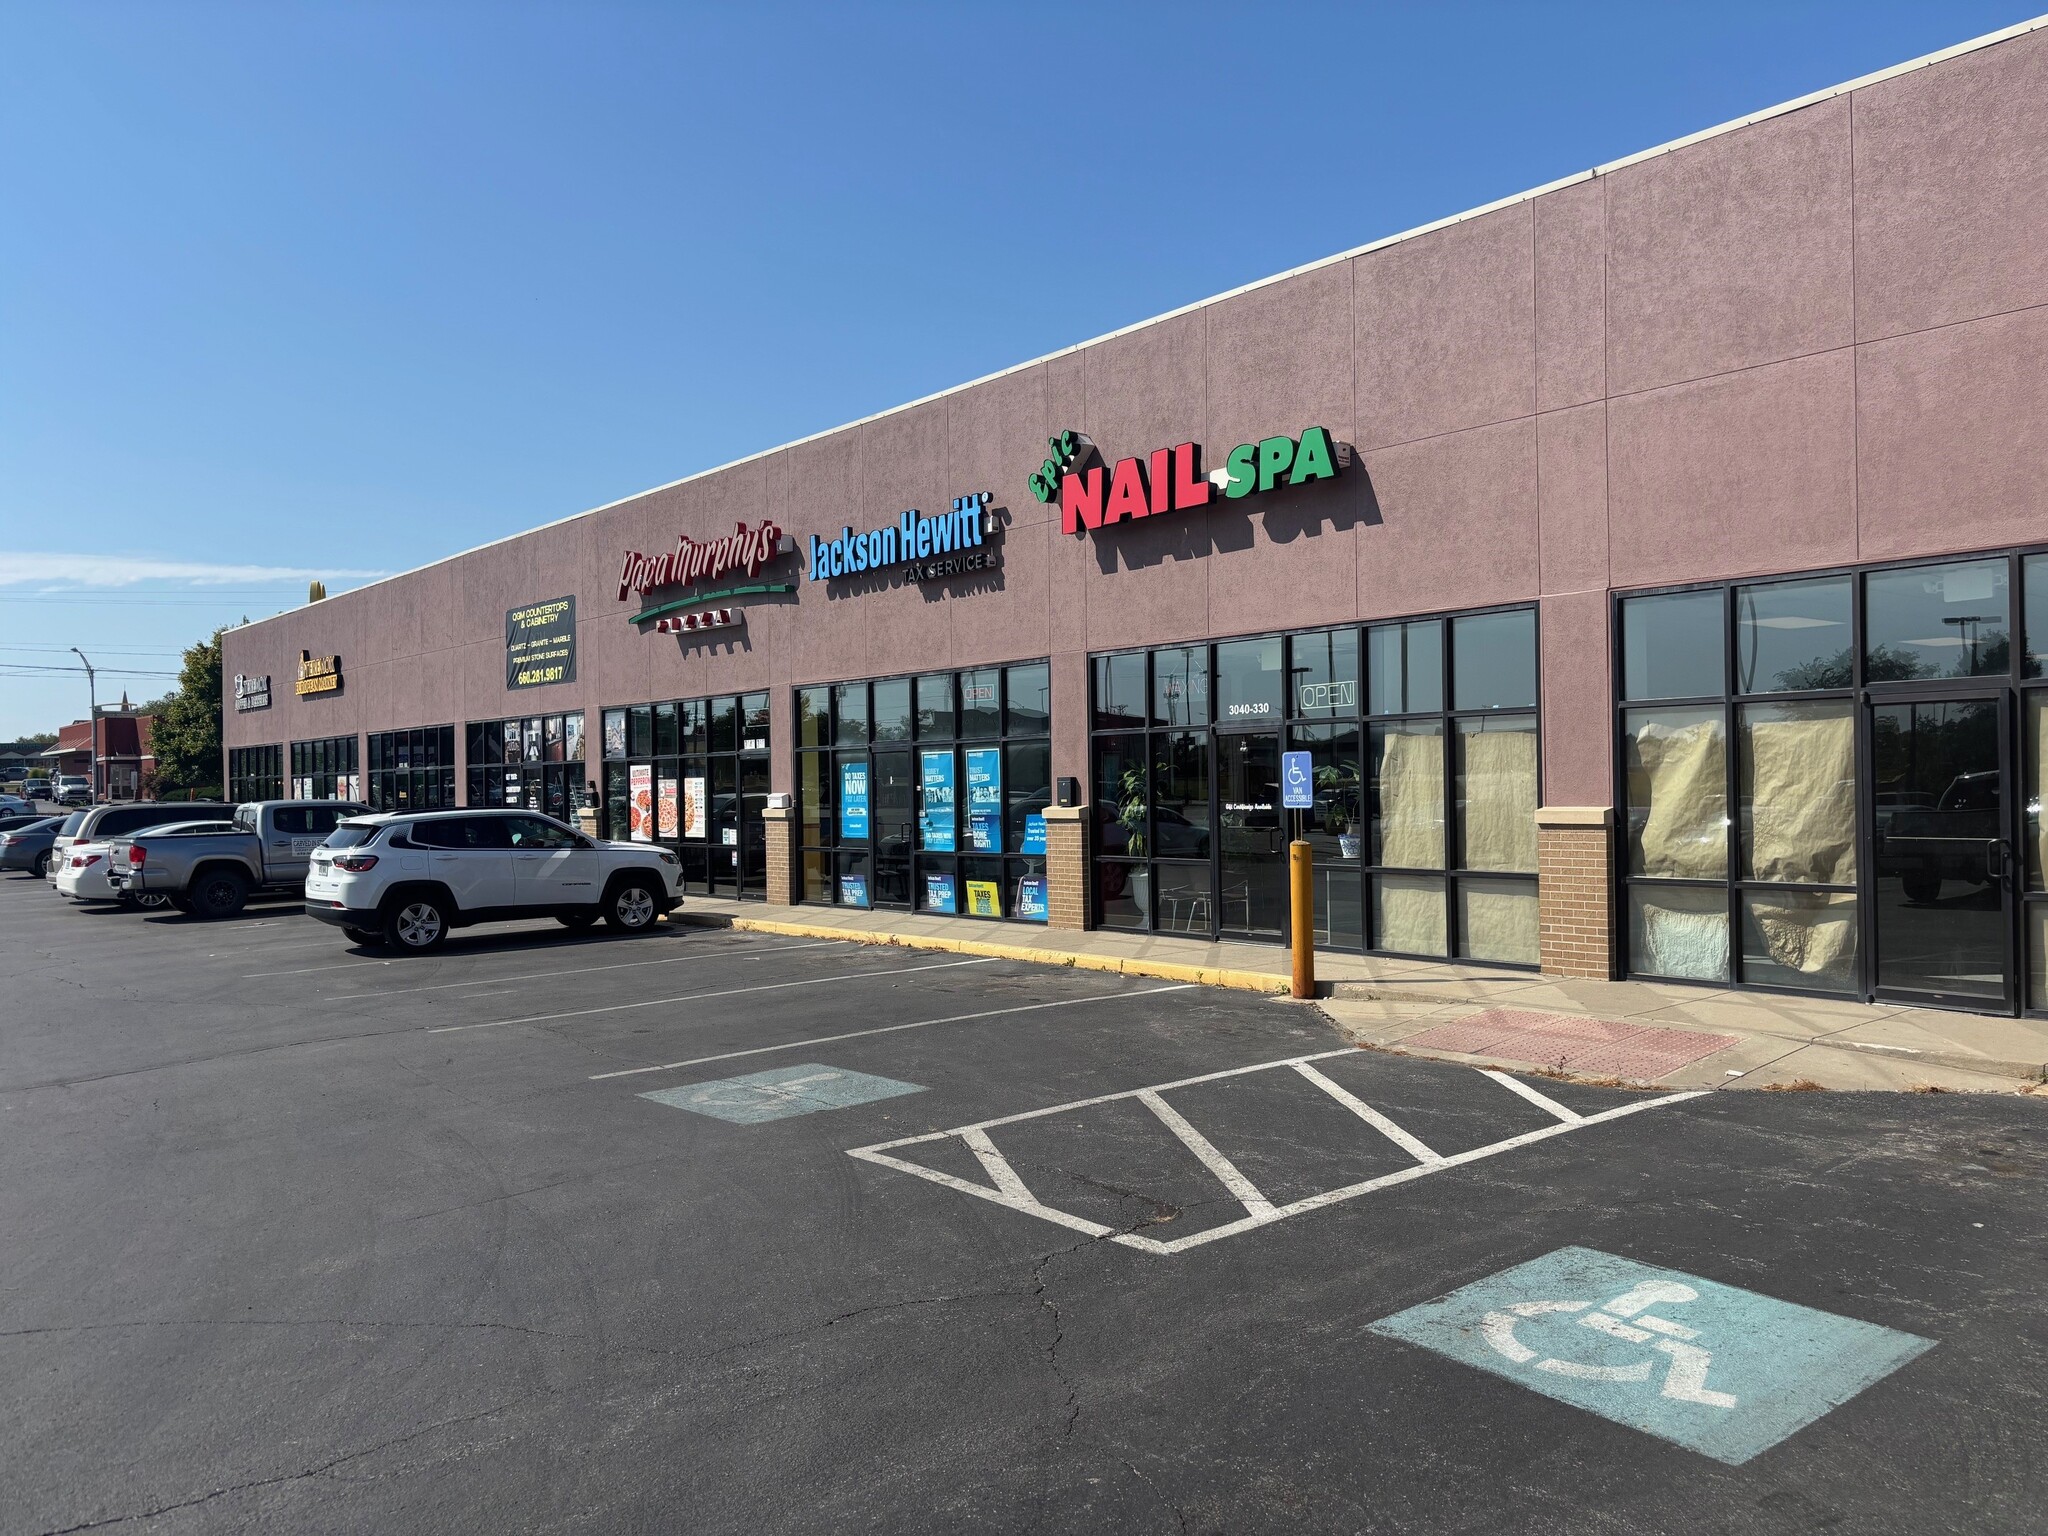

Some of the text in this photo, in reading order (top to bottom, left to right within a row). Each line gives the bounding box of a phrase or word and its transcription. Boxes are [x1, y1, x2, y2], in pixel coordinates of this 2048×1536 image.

[1028, 430, 1073, 503] Epic
[1062, 426, 1334, 535] NAIL SPA
[809, 492, 983, 581] Jackson Hewitt
[616, 520, 781, 601] Papa Murphy's
[903, 553, 984, 583] TAX SERVICE
[526, 601, 569, 618] COUNTERTOPS
[526, 613, 559, 628] CABINETRY
[530, 638, 549, 648] GRANITE
[552, 634, 571, 644] MARBLE
[965, 686, 993, 699] OPEN
[1302, 683, 1352, 707] OPEN
[1228, 703, 1270, 715] 3040-330
[852, 772, 866, 780] TAXES
[845, 780, 866, 795] NOW
[1292, 786, 1303, 795] VAN
[1285, 795, 1311, 803] ACCESSIBLE
[972, 822, 989, 831] TAXES
[842, 889, 864, 897] TAX PREP
[928, 889, 952, 899] TAX PREP
[974, 890, 991, 899] TAXES
[1023, 886, 1039, 896] LOCAL
[1022, 895, 1033, 903] TAX
[1020, 902, 1045, 912] EXPERTS
